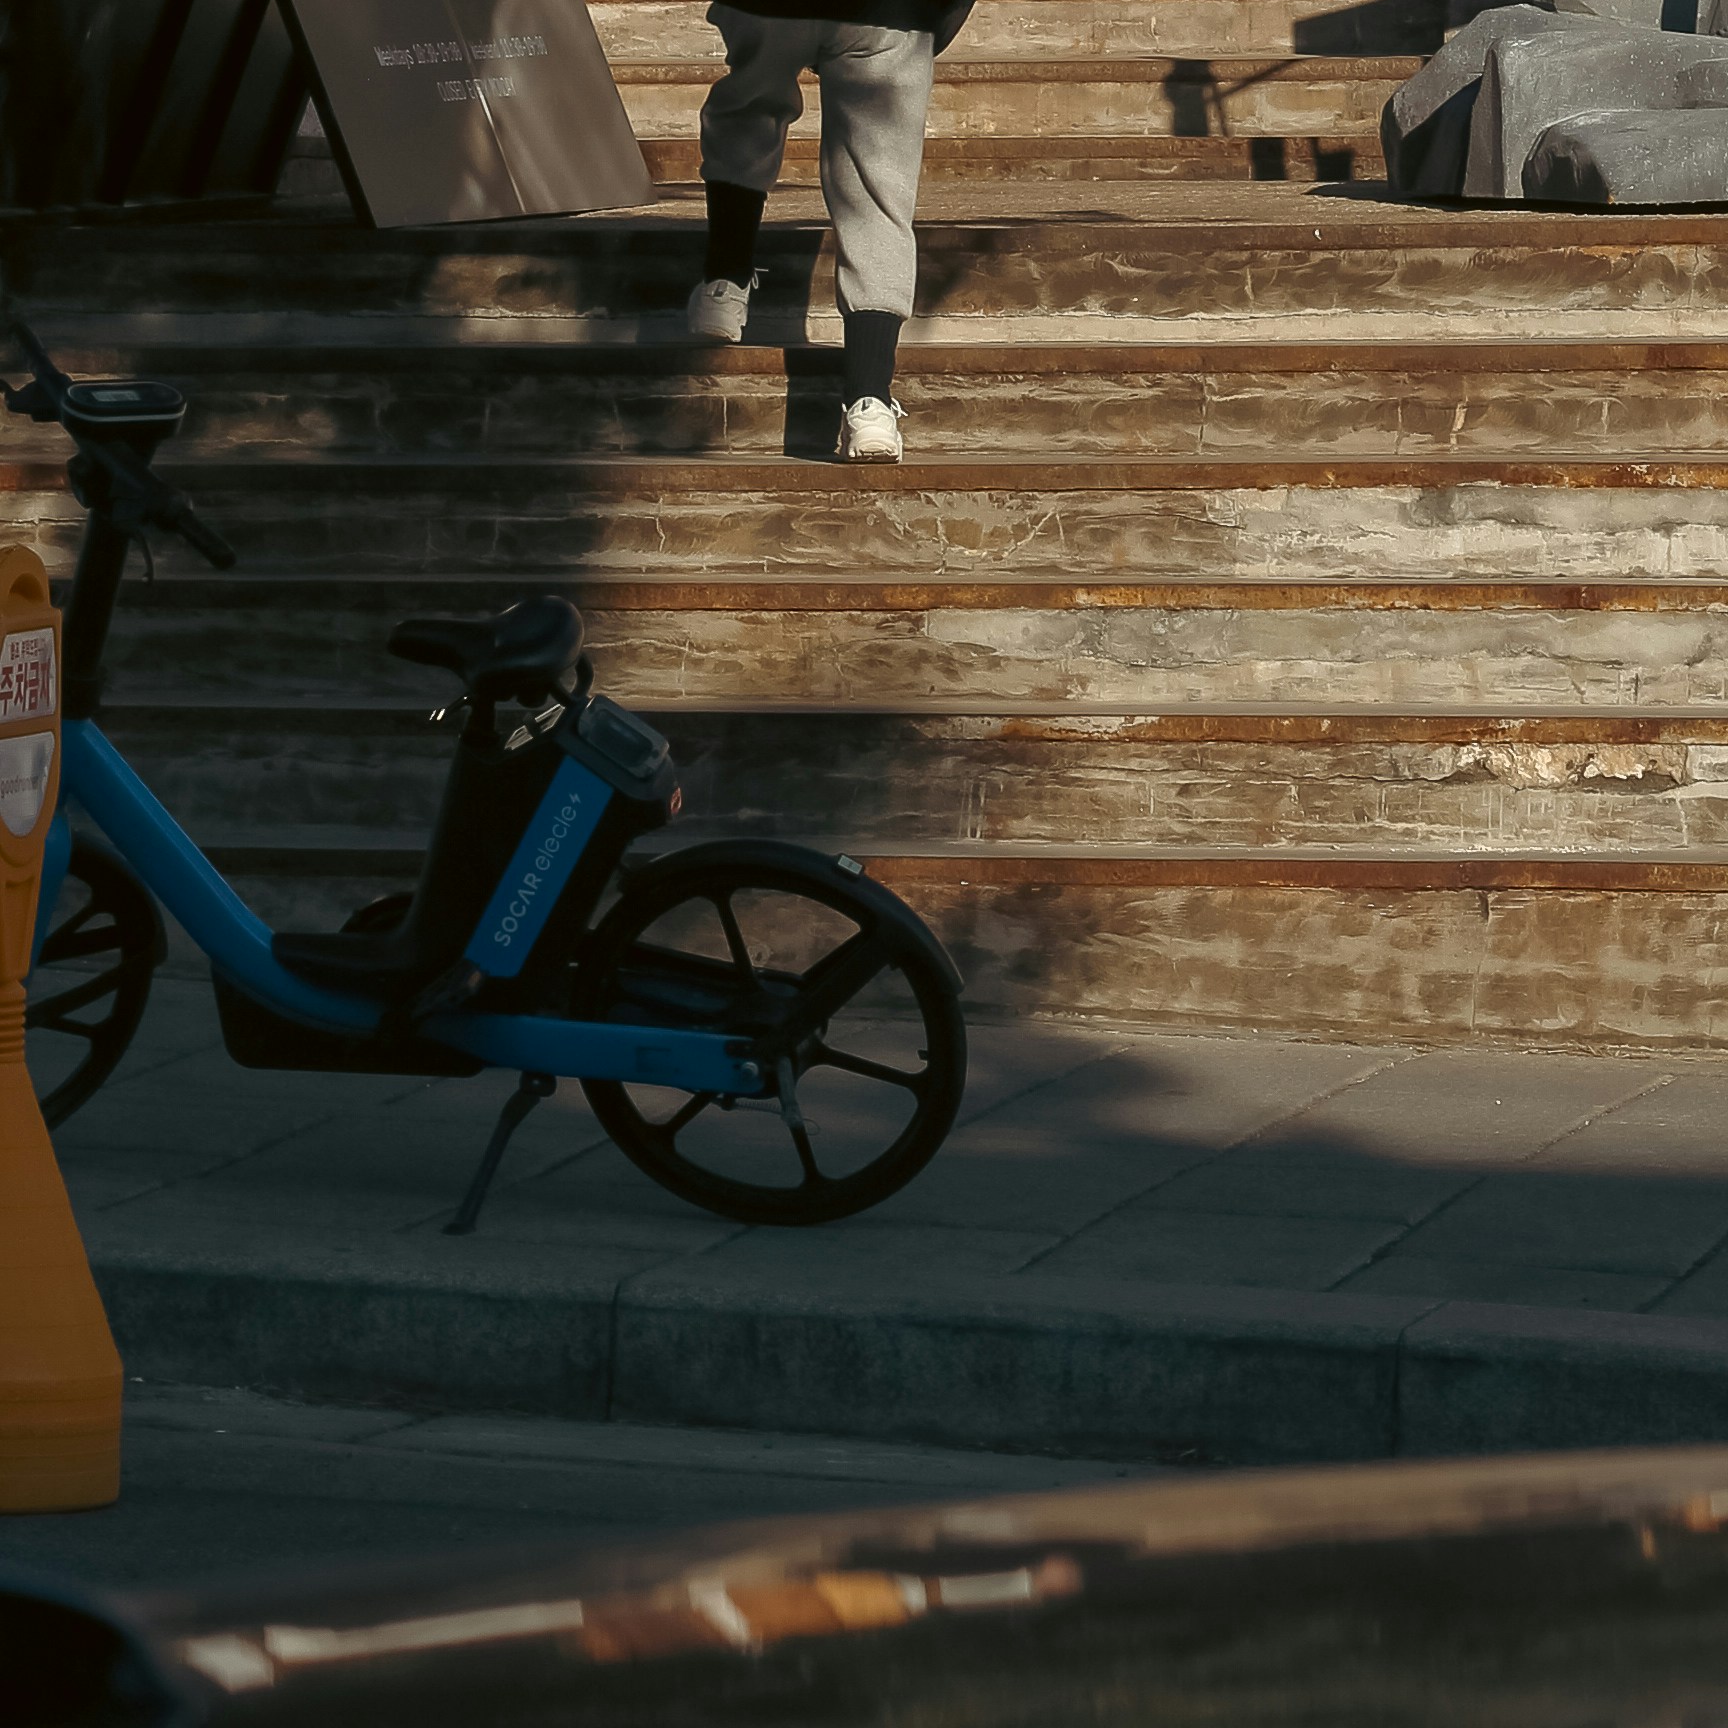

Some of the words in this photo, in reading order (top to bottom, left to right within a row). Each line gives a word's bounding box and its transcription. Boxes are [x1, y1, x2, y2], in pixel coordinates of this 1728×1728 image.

[0, 657, 50, 716] 주차금지
[494, 872, 543, 947] SOCAR
[535, 805, 577, 871] elecle
